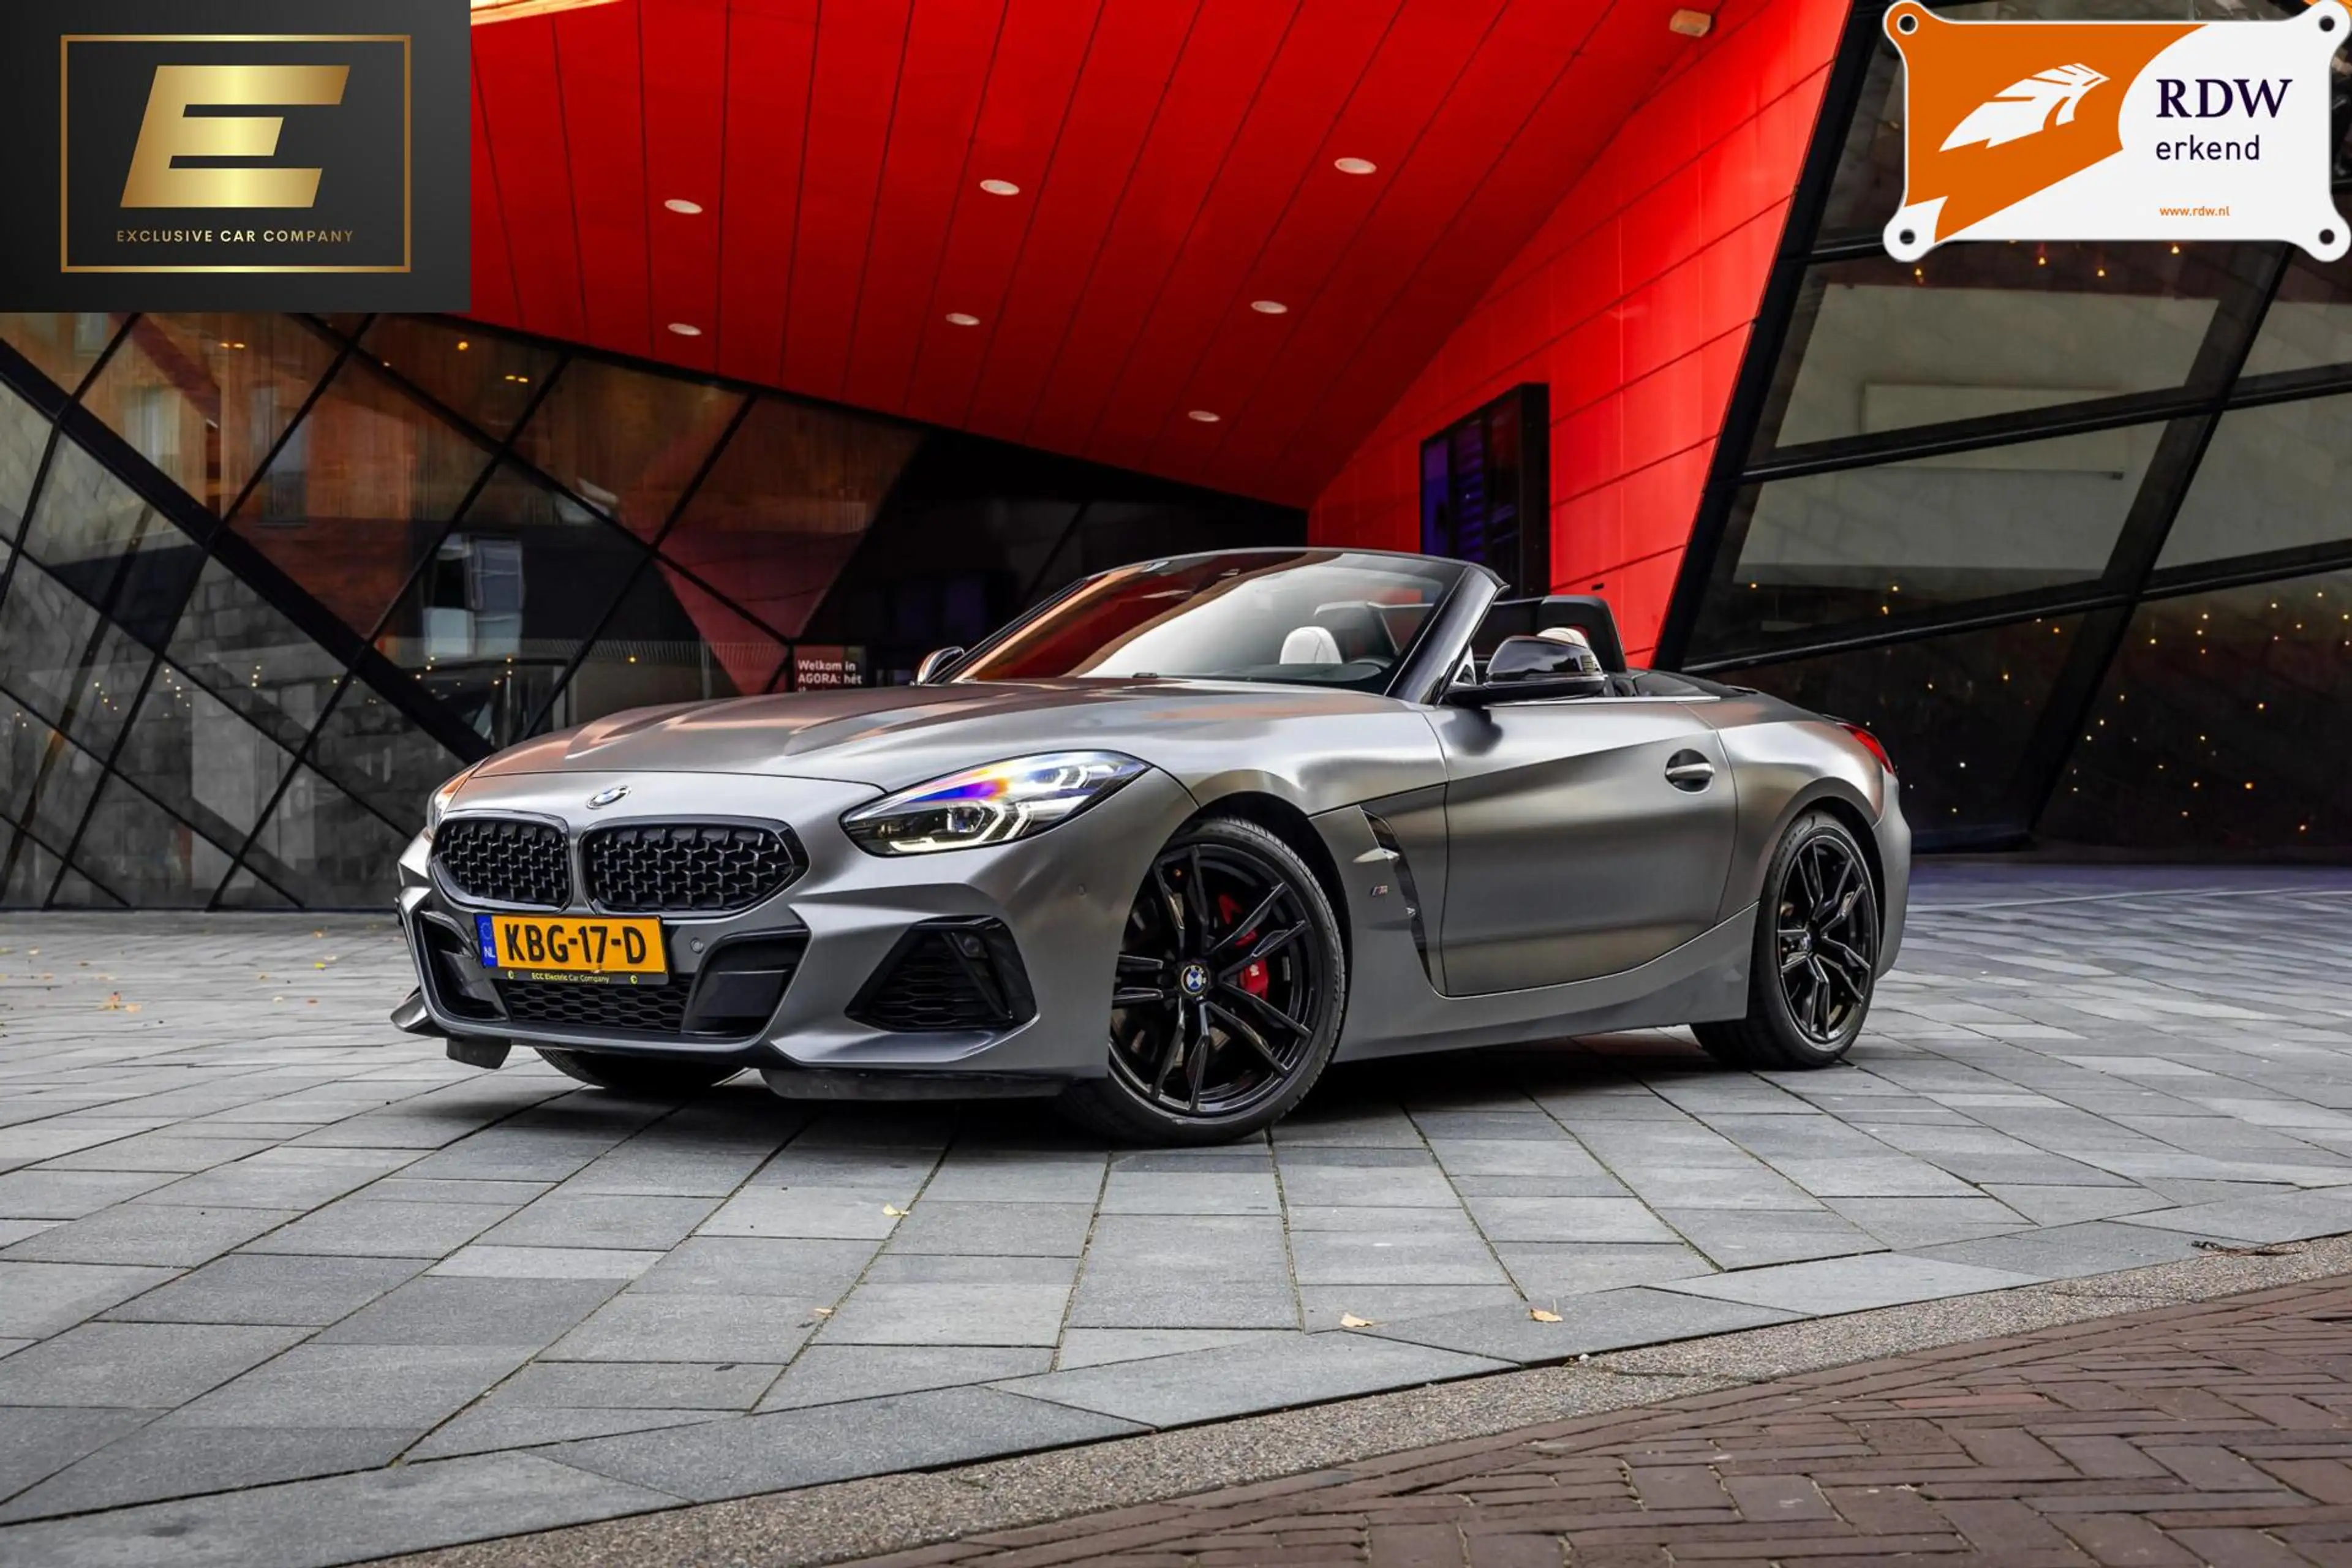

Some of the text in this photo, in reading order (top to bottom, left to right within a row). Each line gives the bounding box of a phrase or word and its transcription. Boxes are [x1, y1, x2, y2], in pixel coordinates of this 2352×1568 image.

[797, 659, 856, 671] Welkom in
[798, 673, 841, 684] AGORA:
[484, 923, 647, 964] NL KBG-17-D
[545, 973, 568, 981] Electric
[579, 974, 610, 984] Company
